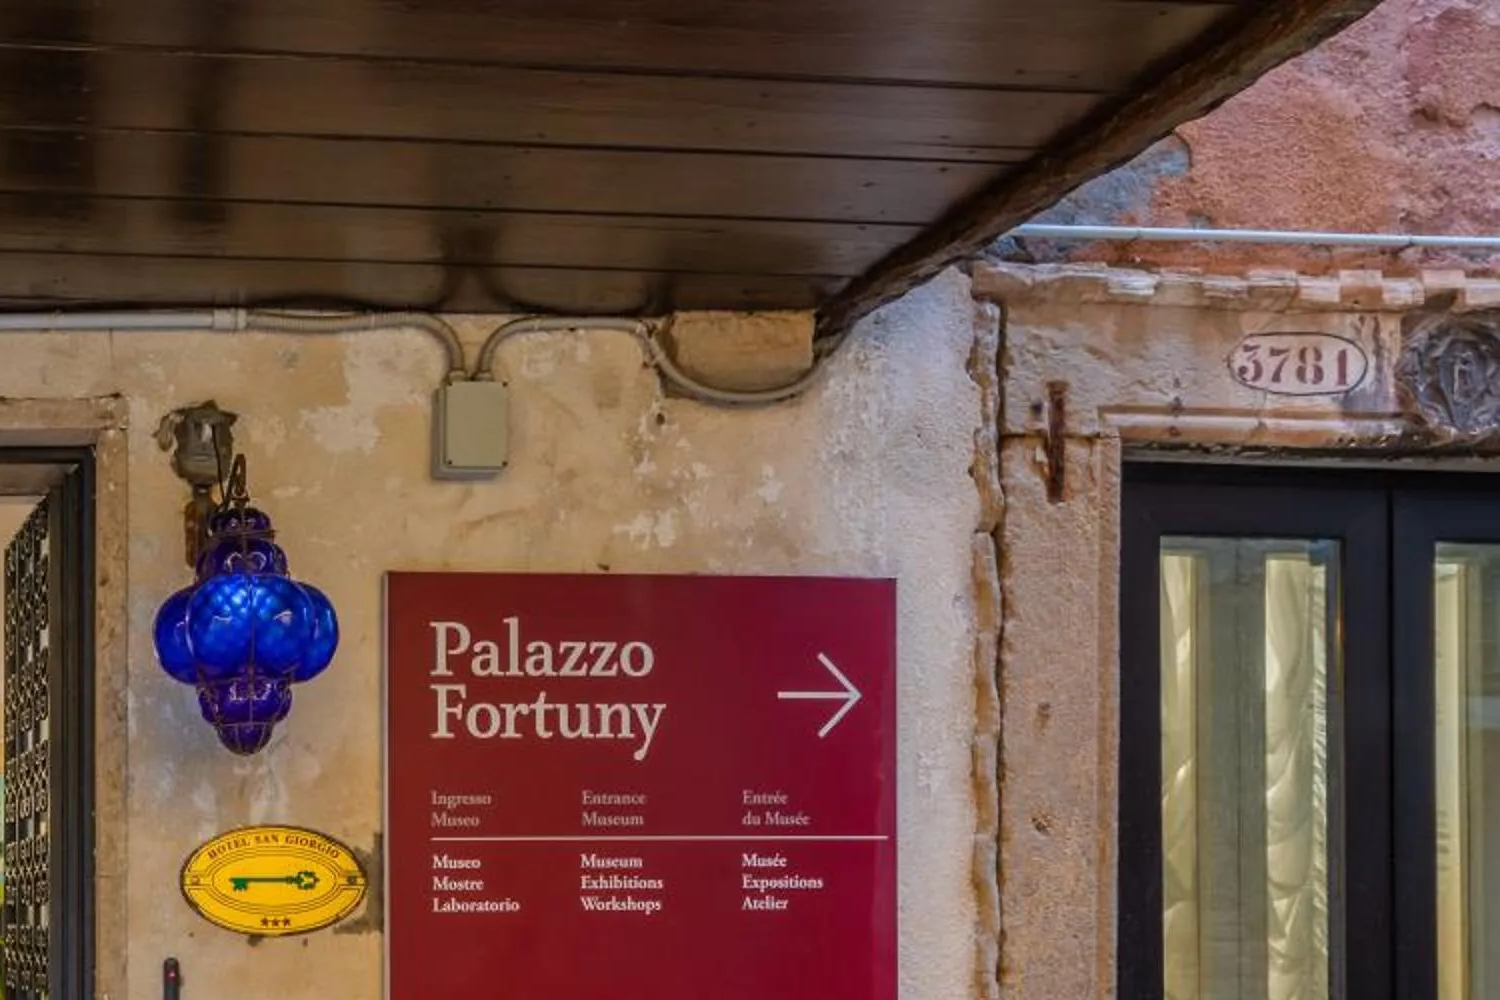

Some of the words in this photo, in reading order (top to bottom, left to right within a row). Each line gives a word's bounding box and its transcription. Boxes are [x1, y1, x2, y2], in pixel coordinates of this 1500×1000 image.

[1237, 343, 1350, 387] 3781
[429, 616, 654, 678] Palazzo
[429, 683, 666, 761] Fortuny
[431, 790, 493, 809] Ingresso
[581, 789, 646, 805] Entrance
[742, 789, 788, 805] Entrée
[431, 811, 480, 827] Museo
[581, 811, 644, 826] Museum
[742, 811, 761, 826] du
[765, 811, 810, 826] Musée
[207, 838, 250, 860] HOTEL
[254, 833, 280, 845] SAN
[285, 835, 341, 860] GIORGIO
[432, 854, 482, 870] Museo
[580, 853, 644, 869] Museum
[742, 852, 788, 868] Musée
[432, 875, 485, 891] Mostre
[580, 874, 664, 890] Exhibitions
[742, 874, 824, 893] Expositions
[432, 897, 520, 913] Laboratorio
[580, 896, 662, 915] Workshops
[742, 896, 788, 911] Atelier
